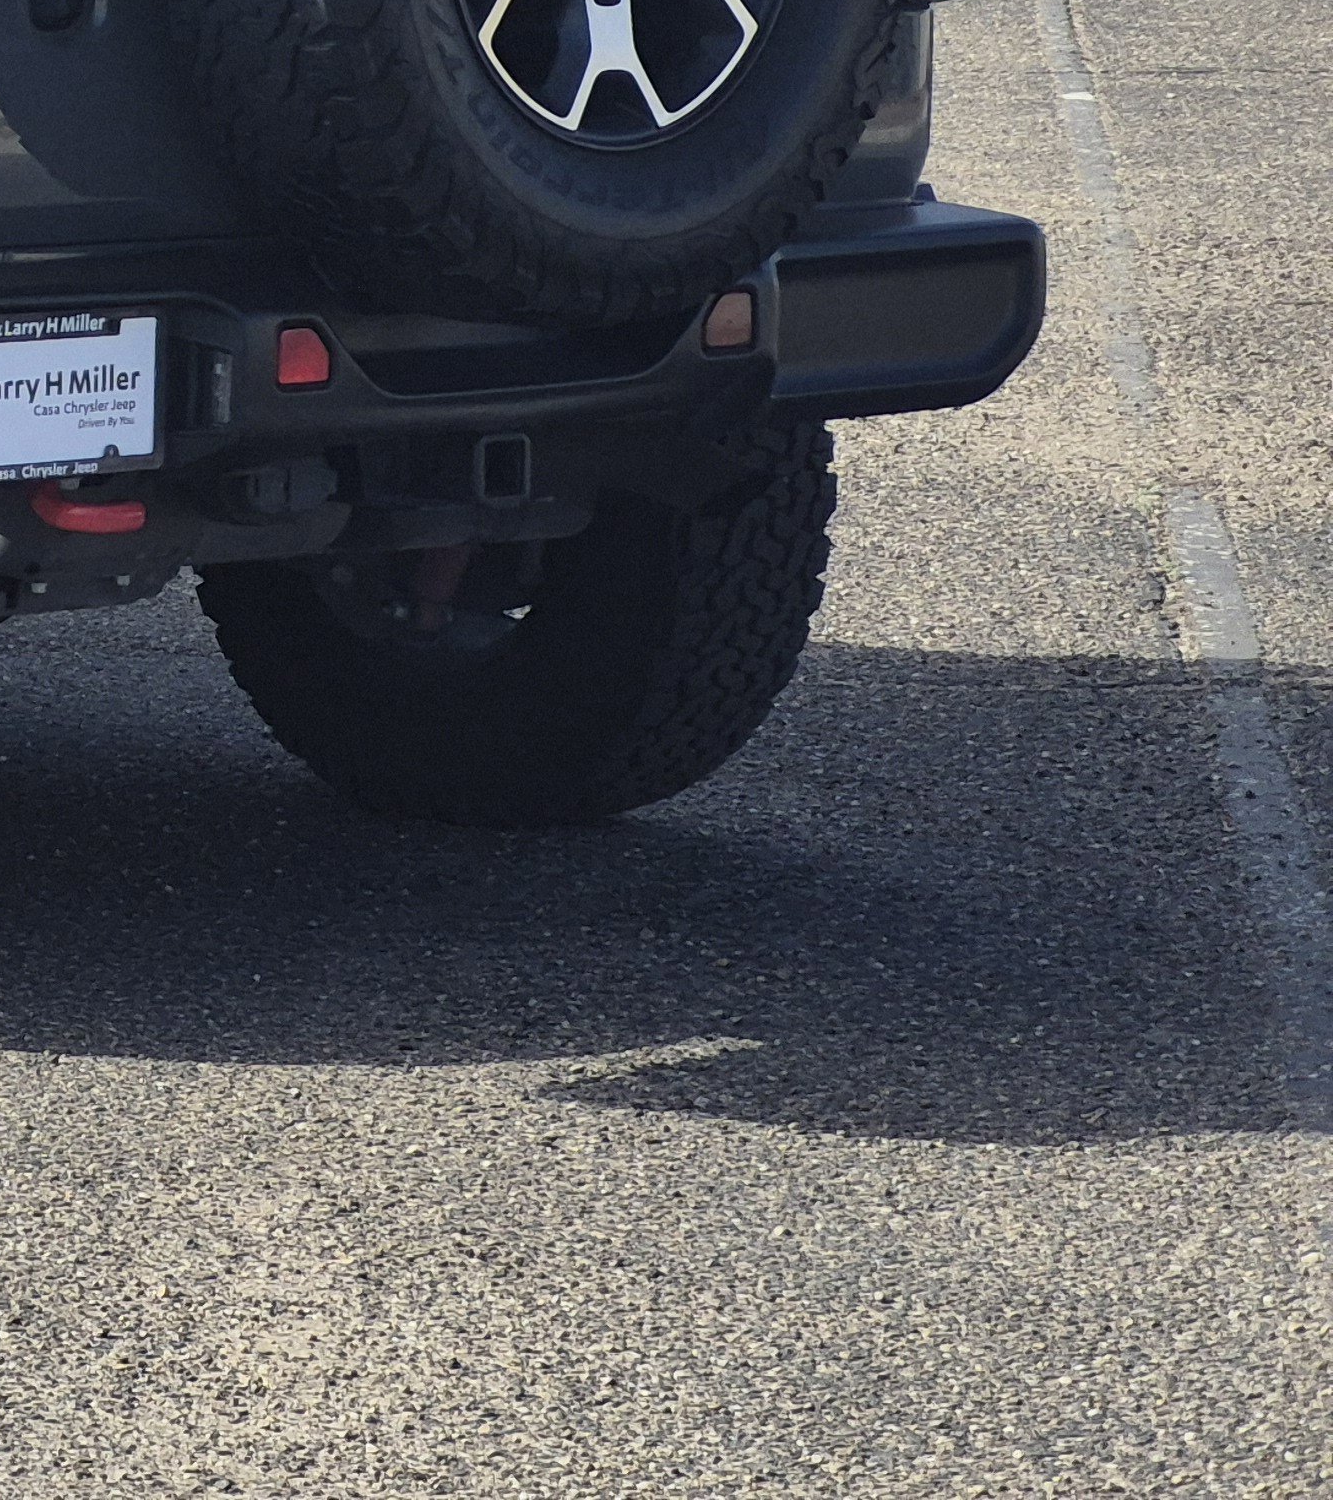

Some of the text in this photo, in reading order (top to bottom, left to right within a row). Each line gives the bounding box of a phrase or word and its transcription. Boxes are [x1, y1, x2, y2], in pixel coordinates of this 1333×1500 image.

[4, 313, 106, 339] Larry H Miller
[45, 371, 64, 397] H
[68, 364, 141, 394] Miller
[33, 399, 136, 417] Casa Chrysler Jeep
[21, 463, 69, 479] Chrysler
[72, 461, 99, 475] Jeep
